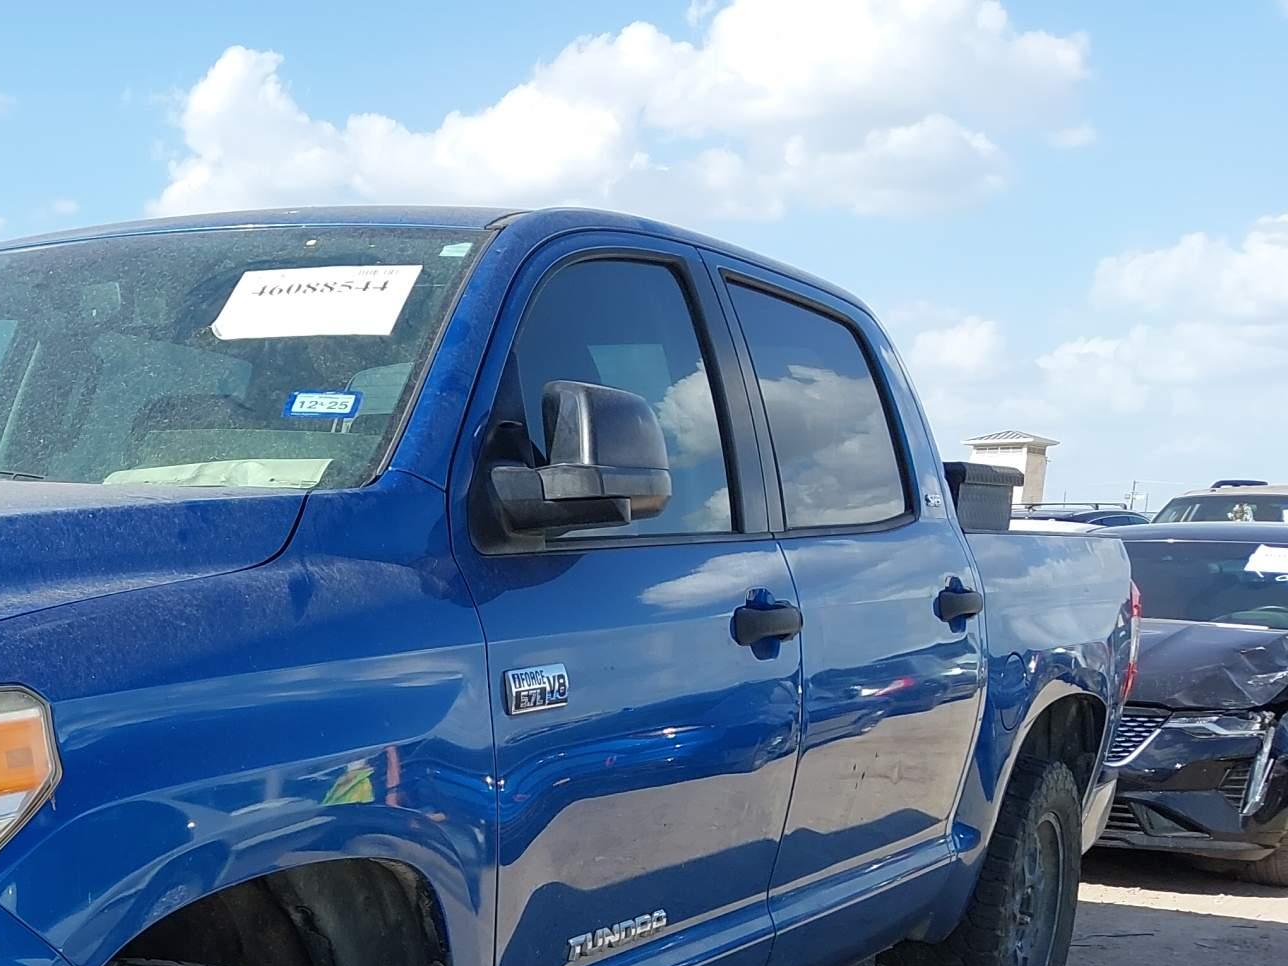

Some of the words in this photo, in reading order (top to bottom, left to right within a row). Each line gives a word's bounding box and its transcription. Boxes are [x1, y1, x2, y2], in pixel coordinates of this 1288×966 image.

[252, 280, 390, 297] 46088544
[546, 674, 567, 700] V8
[568, 909, 668, 961] TUNDRA
